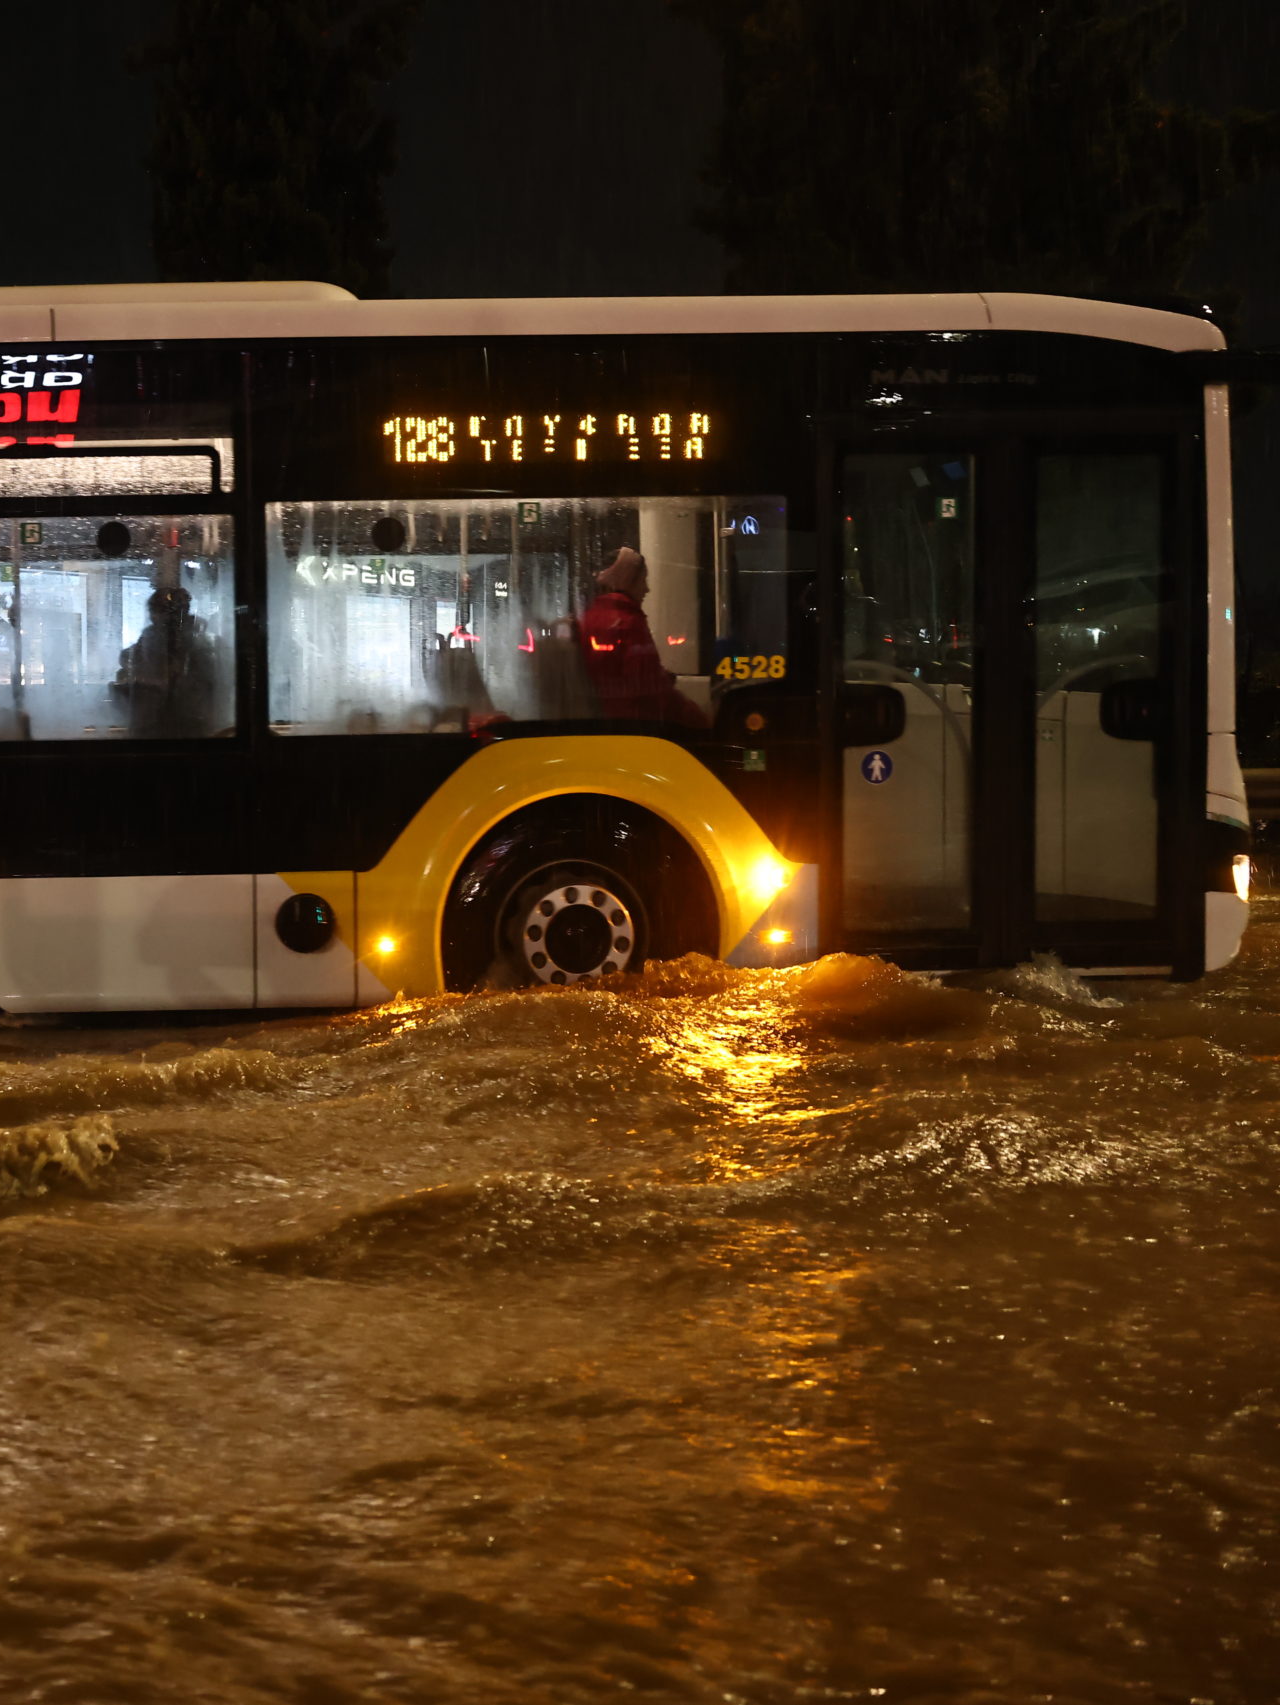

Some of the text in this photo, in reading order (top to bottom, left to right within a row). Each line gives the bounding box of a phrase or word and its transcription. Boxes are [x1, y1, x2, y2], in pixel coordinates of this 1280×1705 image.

[871, 368, 951, 384] MAN
[382, 415, 455, 463] 128
[321, 560, 416, 587] XPENG
[716, 655, 785, 679] 4528
